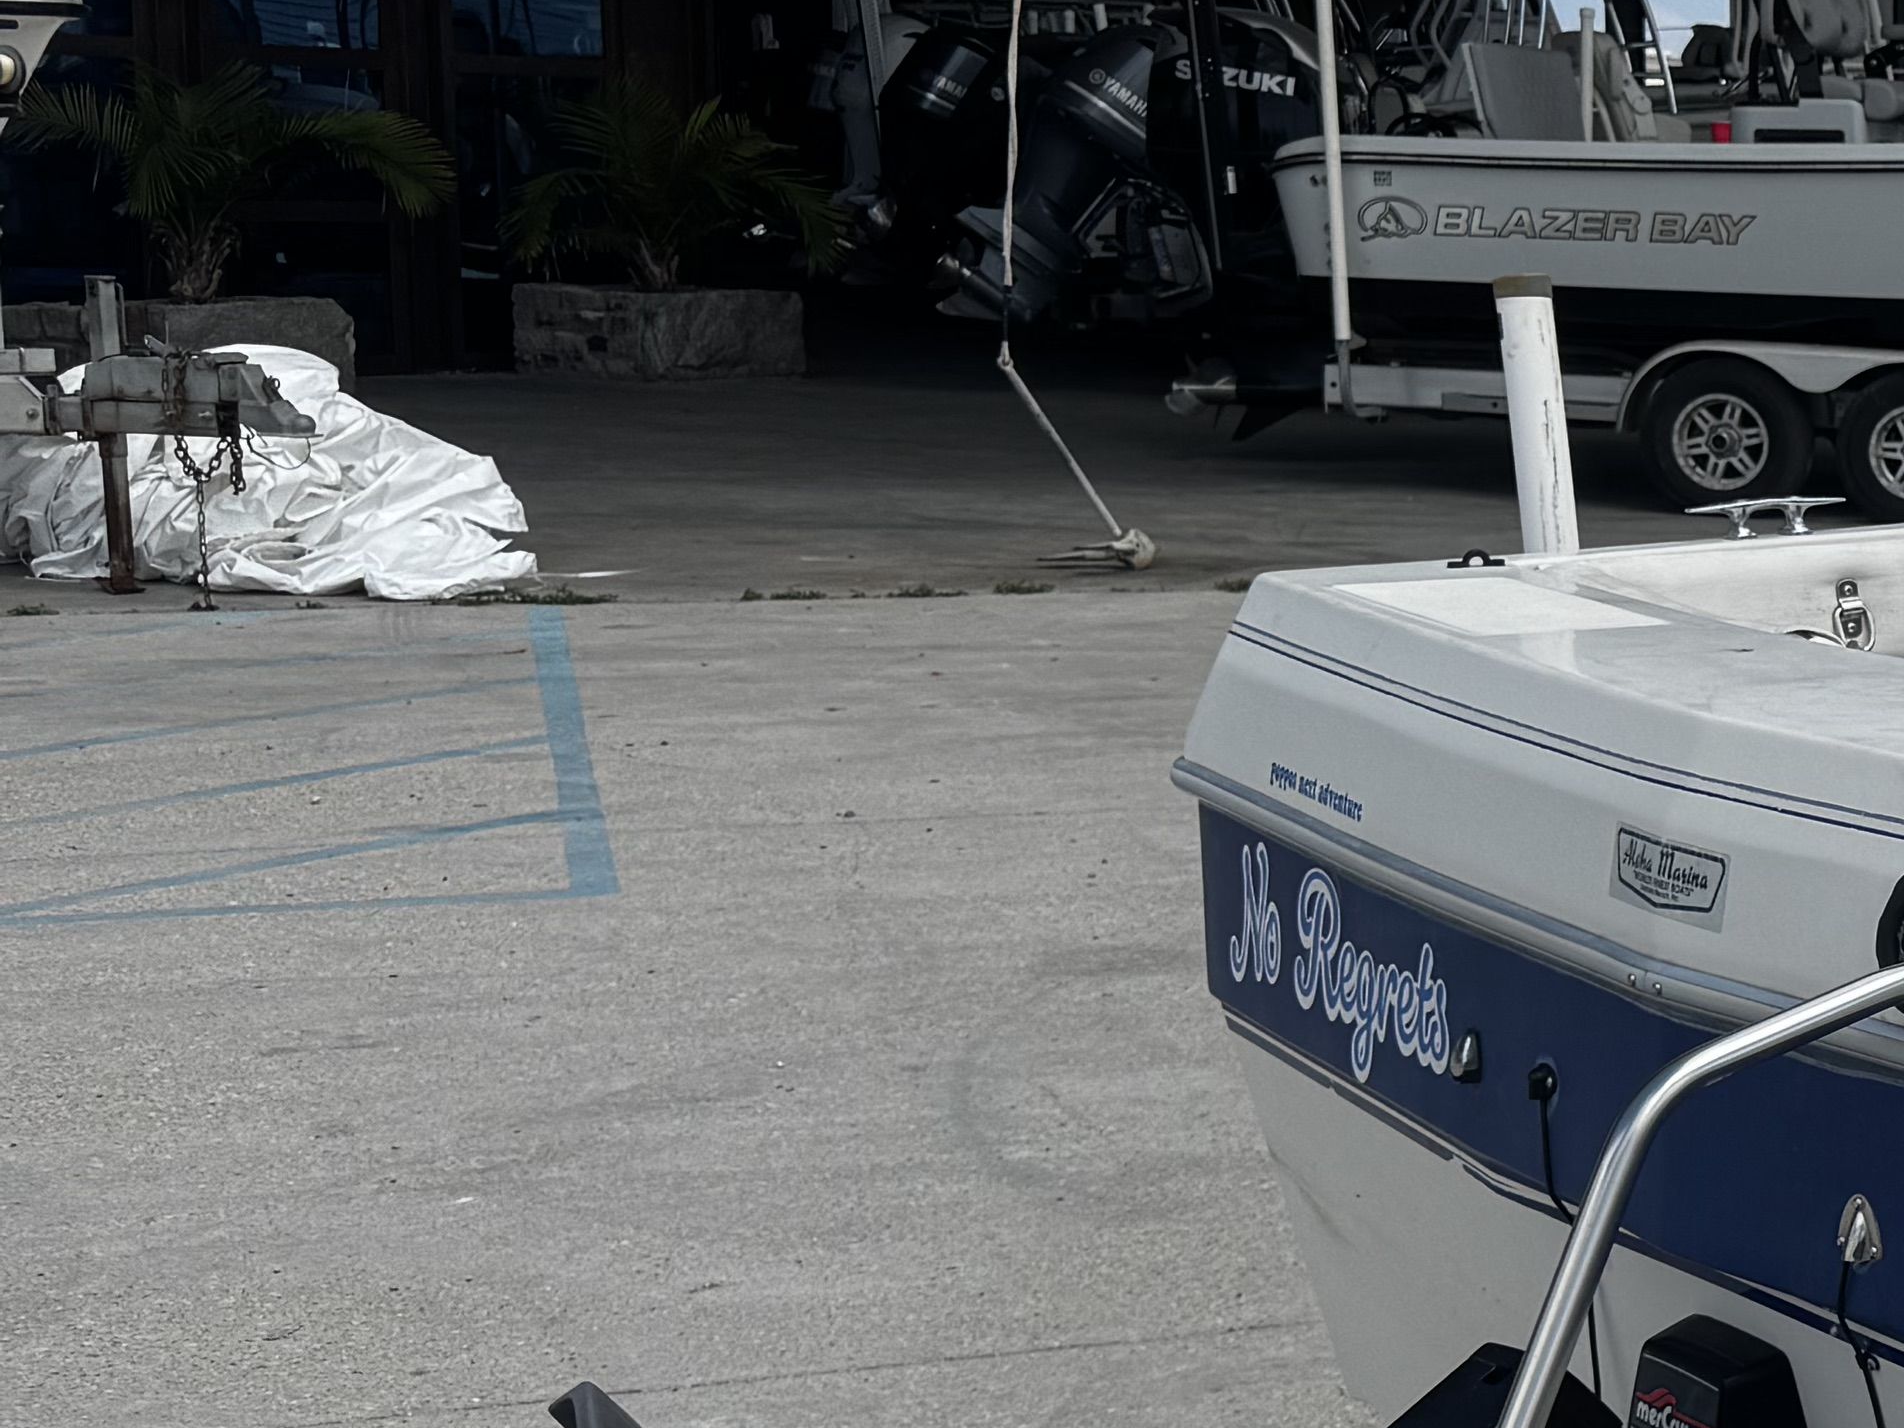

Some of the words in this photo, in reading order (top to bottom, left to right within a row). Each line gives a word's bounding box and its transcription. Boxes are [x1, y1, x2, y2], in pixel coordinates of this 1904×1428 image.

[1175, 59, 1297, 97] SZUKI
[1433, 205, 1642, 243] BLAZER
[1649, 211, 1758, 246] BAY
[1622, 838, 1653, 873] Aloha
[1657, 849, 1709, 891] Marina
[1230, 841, 1281, 985] No
[1294, 867, 1450, 1084] Regrets
